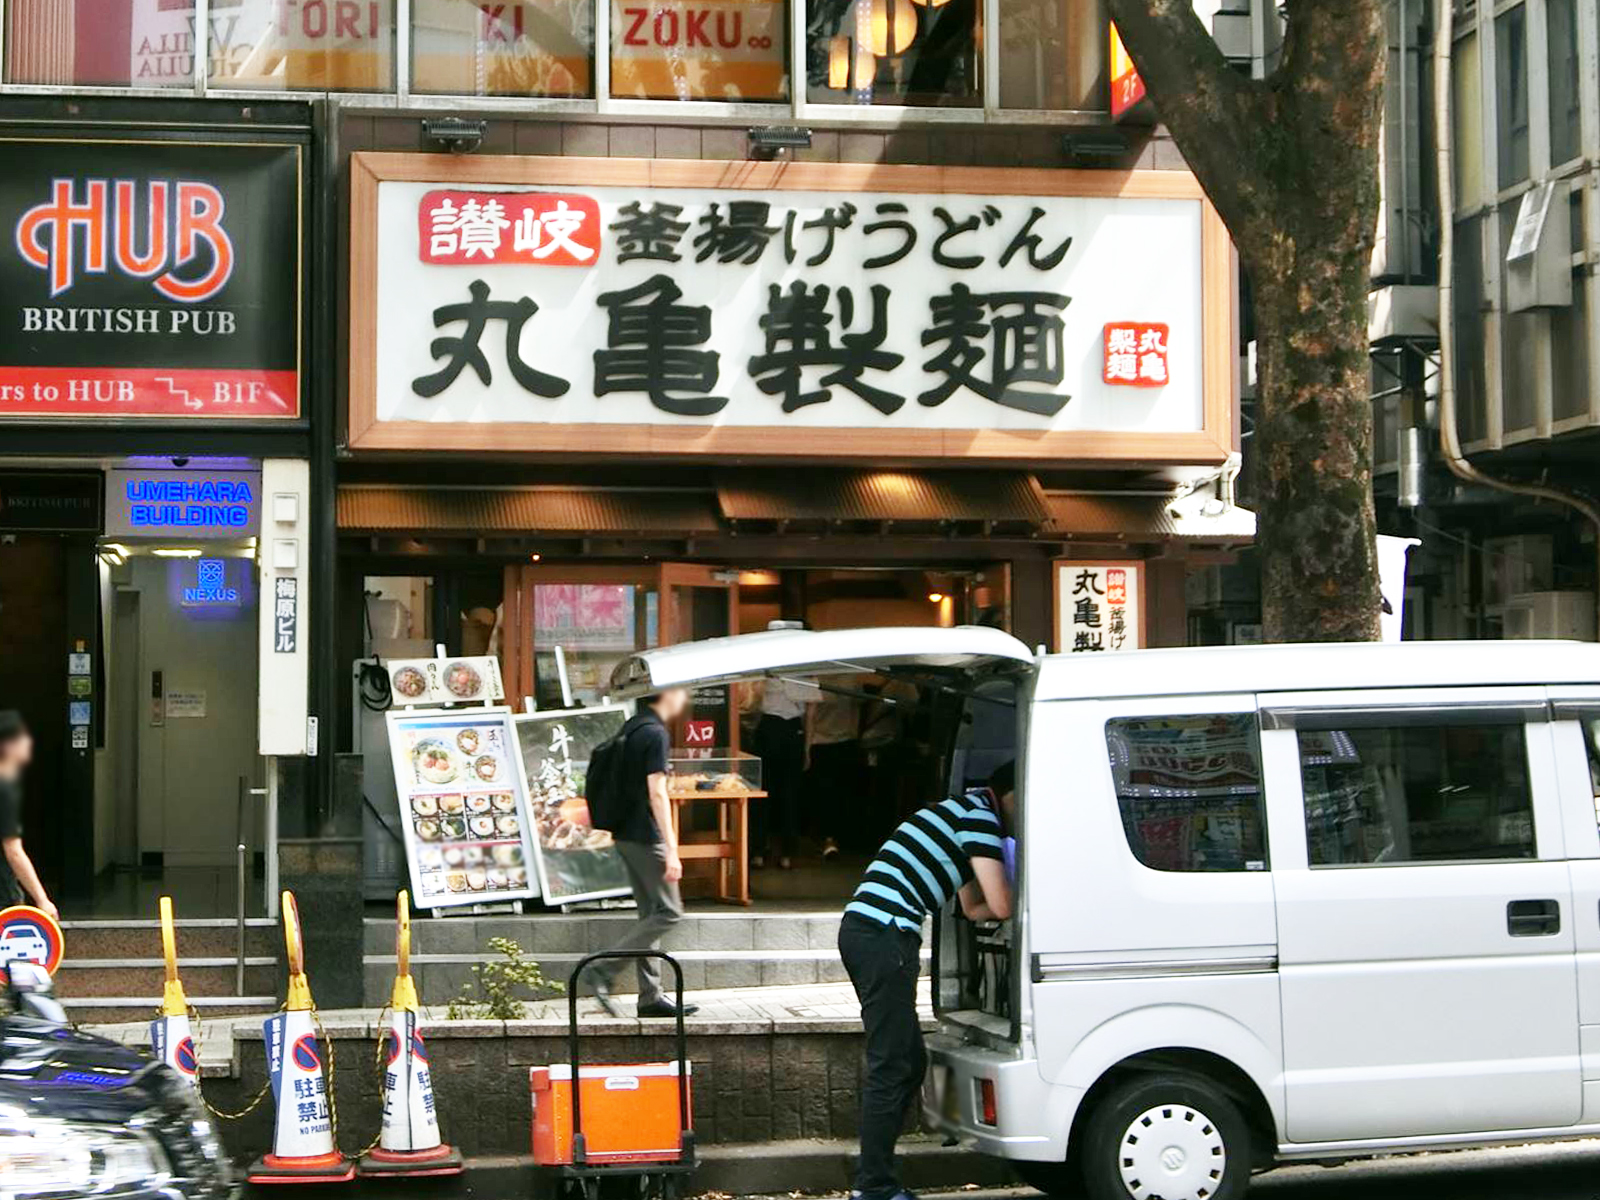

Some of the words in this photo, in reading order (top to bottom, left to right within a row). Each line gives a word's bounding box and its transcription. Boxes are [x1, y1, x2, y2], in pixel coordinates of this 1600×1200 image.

[16, 179, 235, 302] HUB
[608, 200, 1074, 270] 釜揚げうどん
[22, 307, 159, 333] BRITISH
[169, 310, 236, 334] PUB
[412, 272, 1073, 416] 丸亀製麺
[0, 385, 25, 402] rs
[33, 382, 59, 402] to
[67, 379, 135, 402] HUB
[212, 381, 263, 404] B1F
[126, 480, 252, 502] UMEHARA
[131, 505, 248, 526] BUILDING
[184, 588, 237, 601] NEXUS
[275, 578, 297, 653] 梅原ビル
[686, 724, 714, 741] 入口
